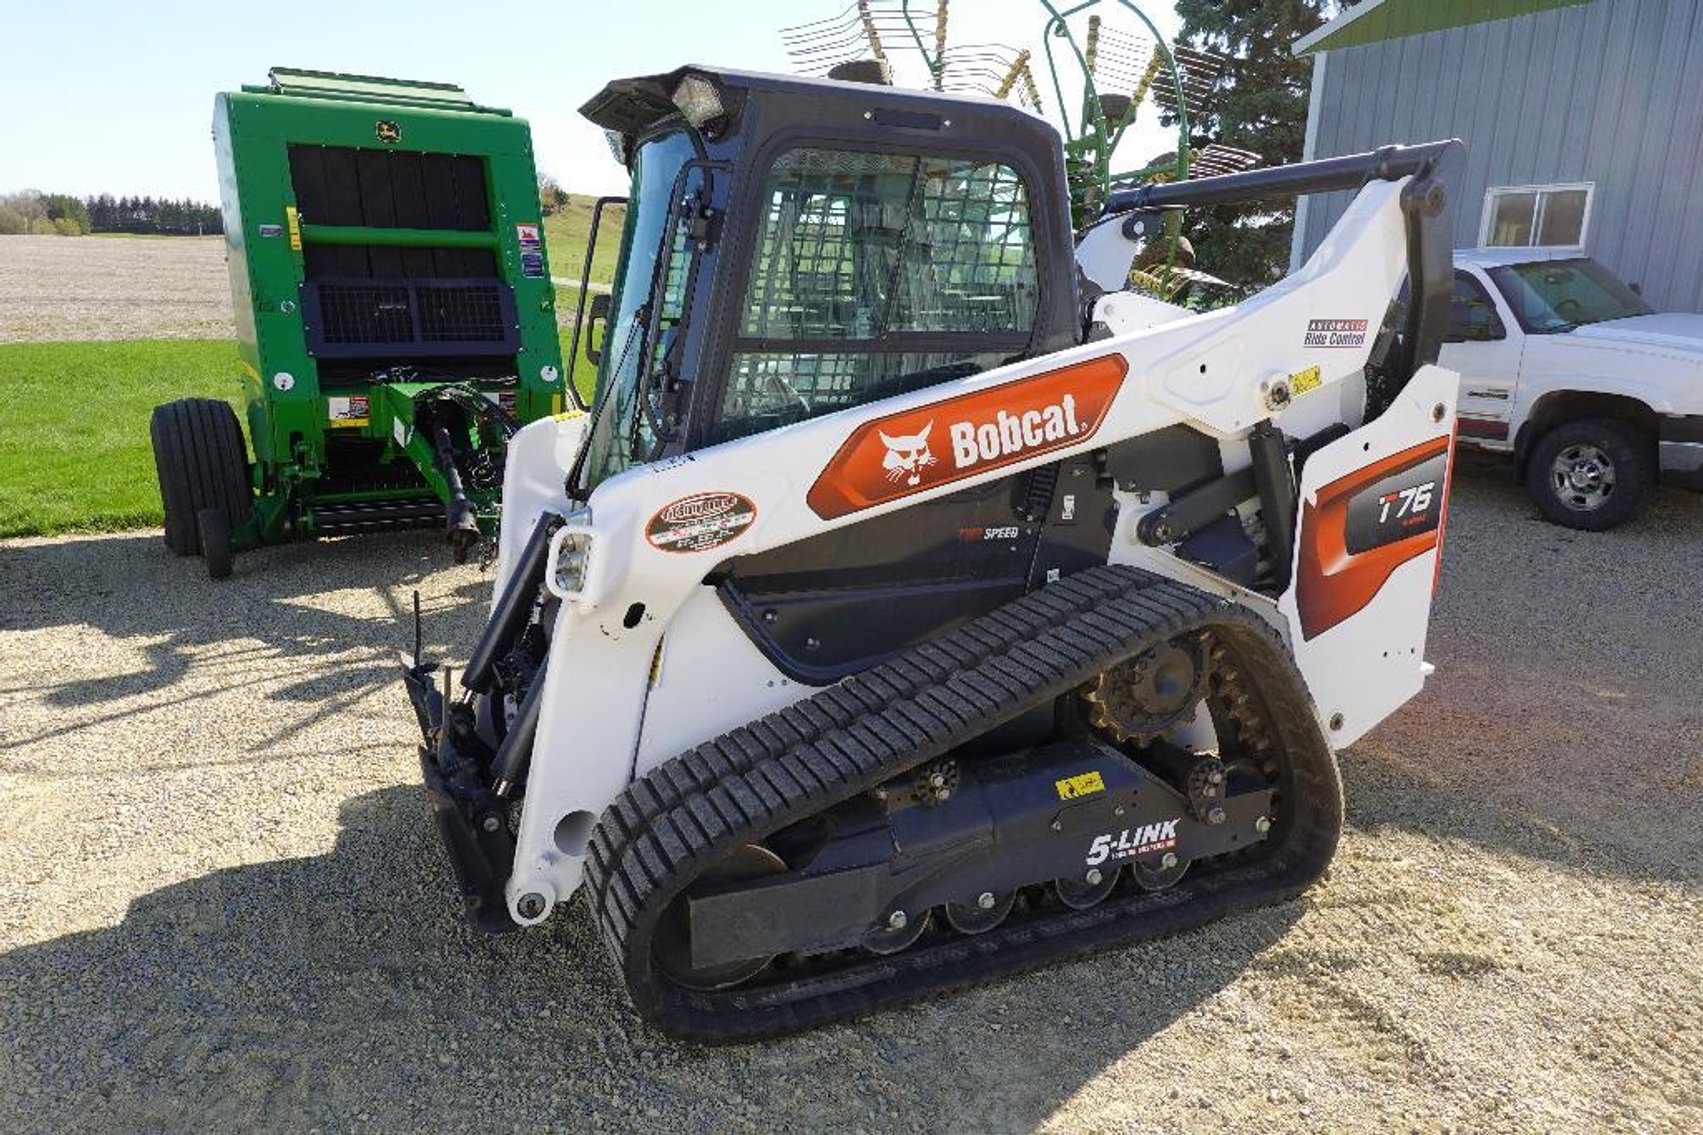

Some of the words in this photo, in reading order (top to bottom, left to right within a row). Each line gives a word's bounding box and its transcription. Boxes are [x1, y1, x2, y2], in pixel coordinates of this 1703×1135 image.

[1304, 332, 1327, 345] Ride
[1329, 332, 1366, 345] Control
[1309, 320, 1367, 331] AUTOMATIC
[949, 393, 1079, 469] Bobcat
[1379, 481, 1435, 523] T76
[983, 526, 1018, 540] SPEED
[1086, 817, 1181, 866] 5-LINK
